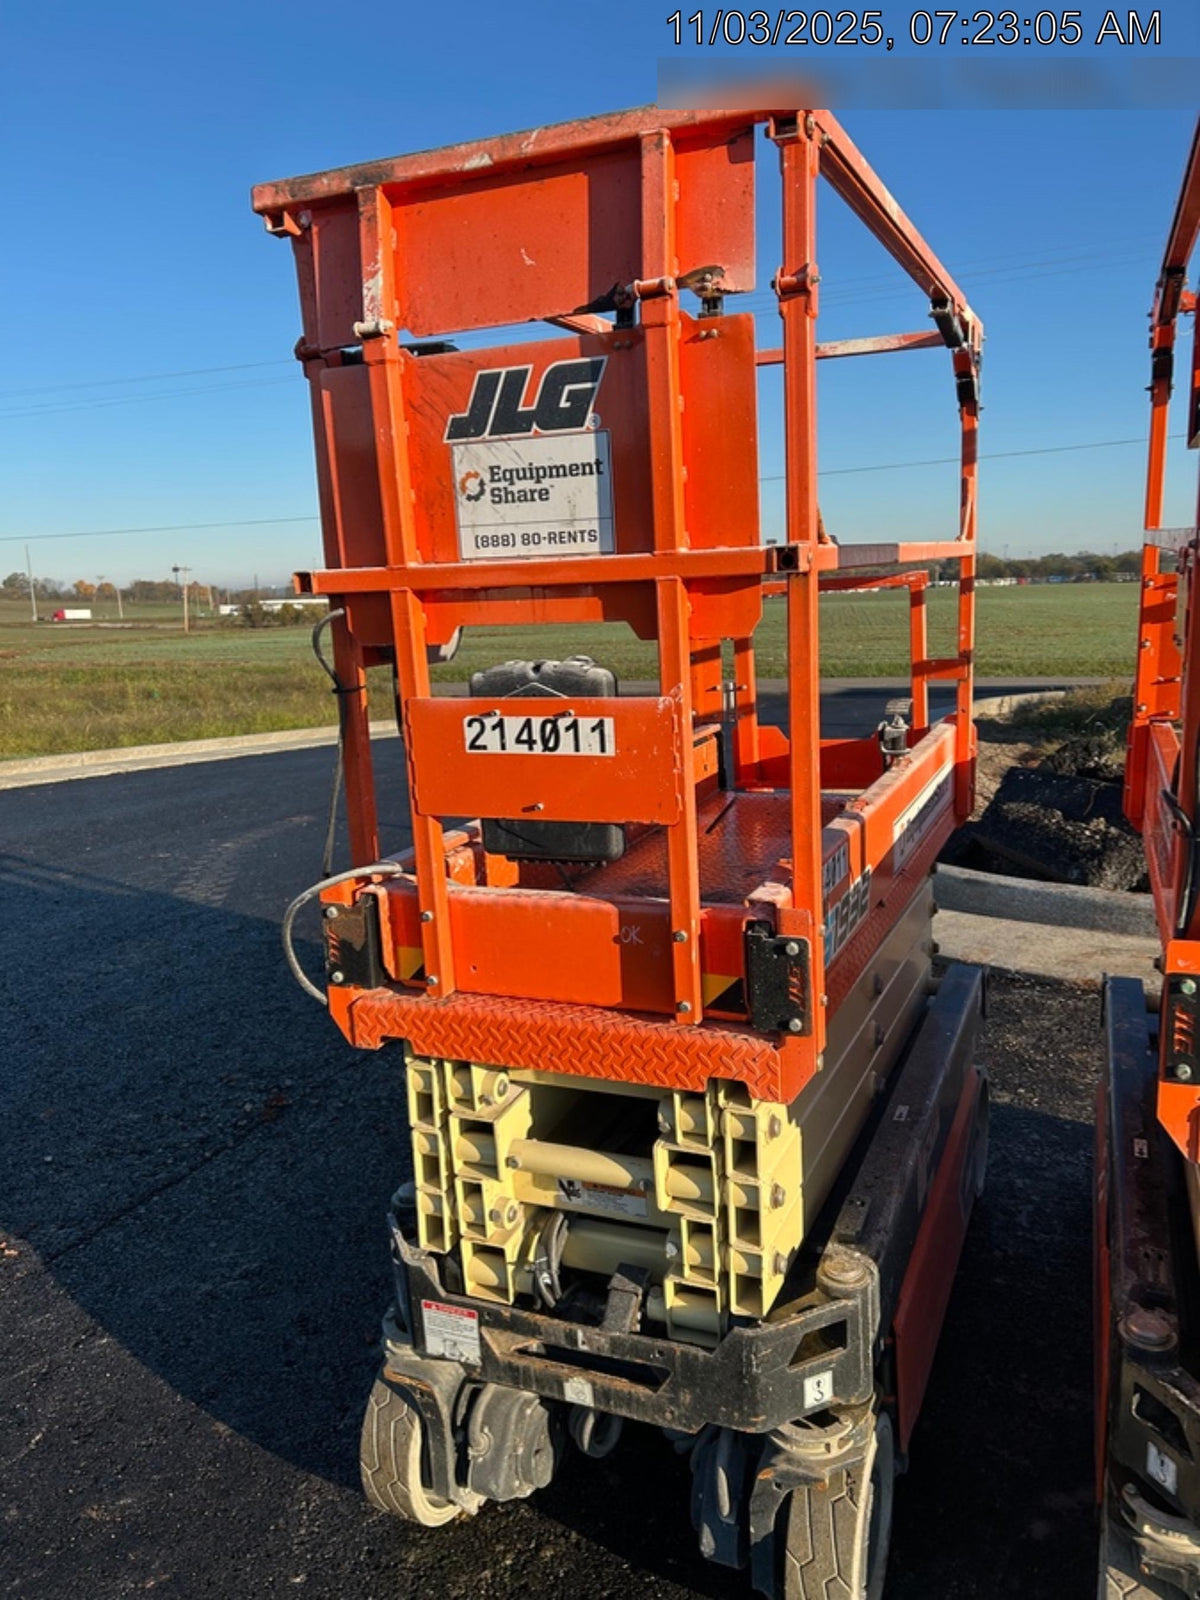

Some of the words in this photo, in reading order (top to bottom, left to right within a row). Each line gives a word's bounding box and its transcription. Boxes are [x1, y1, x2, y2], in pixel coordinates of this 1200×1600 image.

[443, 355, 608, 444] JLG
[488, 458, 604, 486] Equipment
[490, 486, 551, 505] Share
[474, 532, 516, 550] (888)
[520, 529, 599, 546] 80-RENTS
[466, 717, 607, 753] 214011
[620, 925, 645, 945] OK
